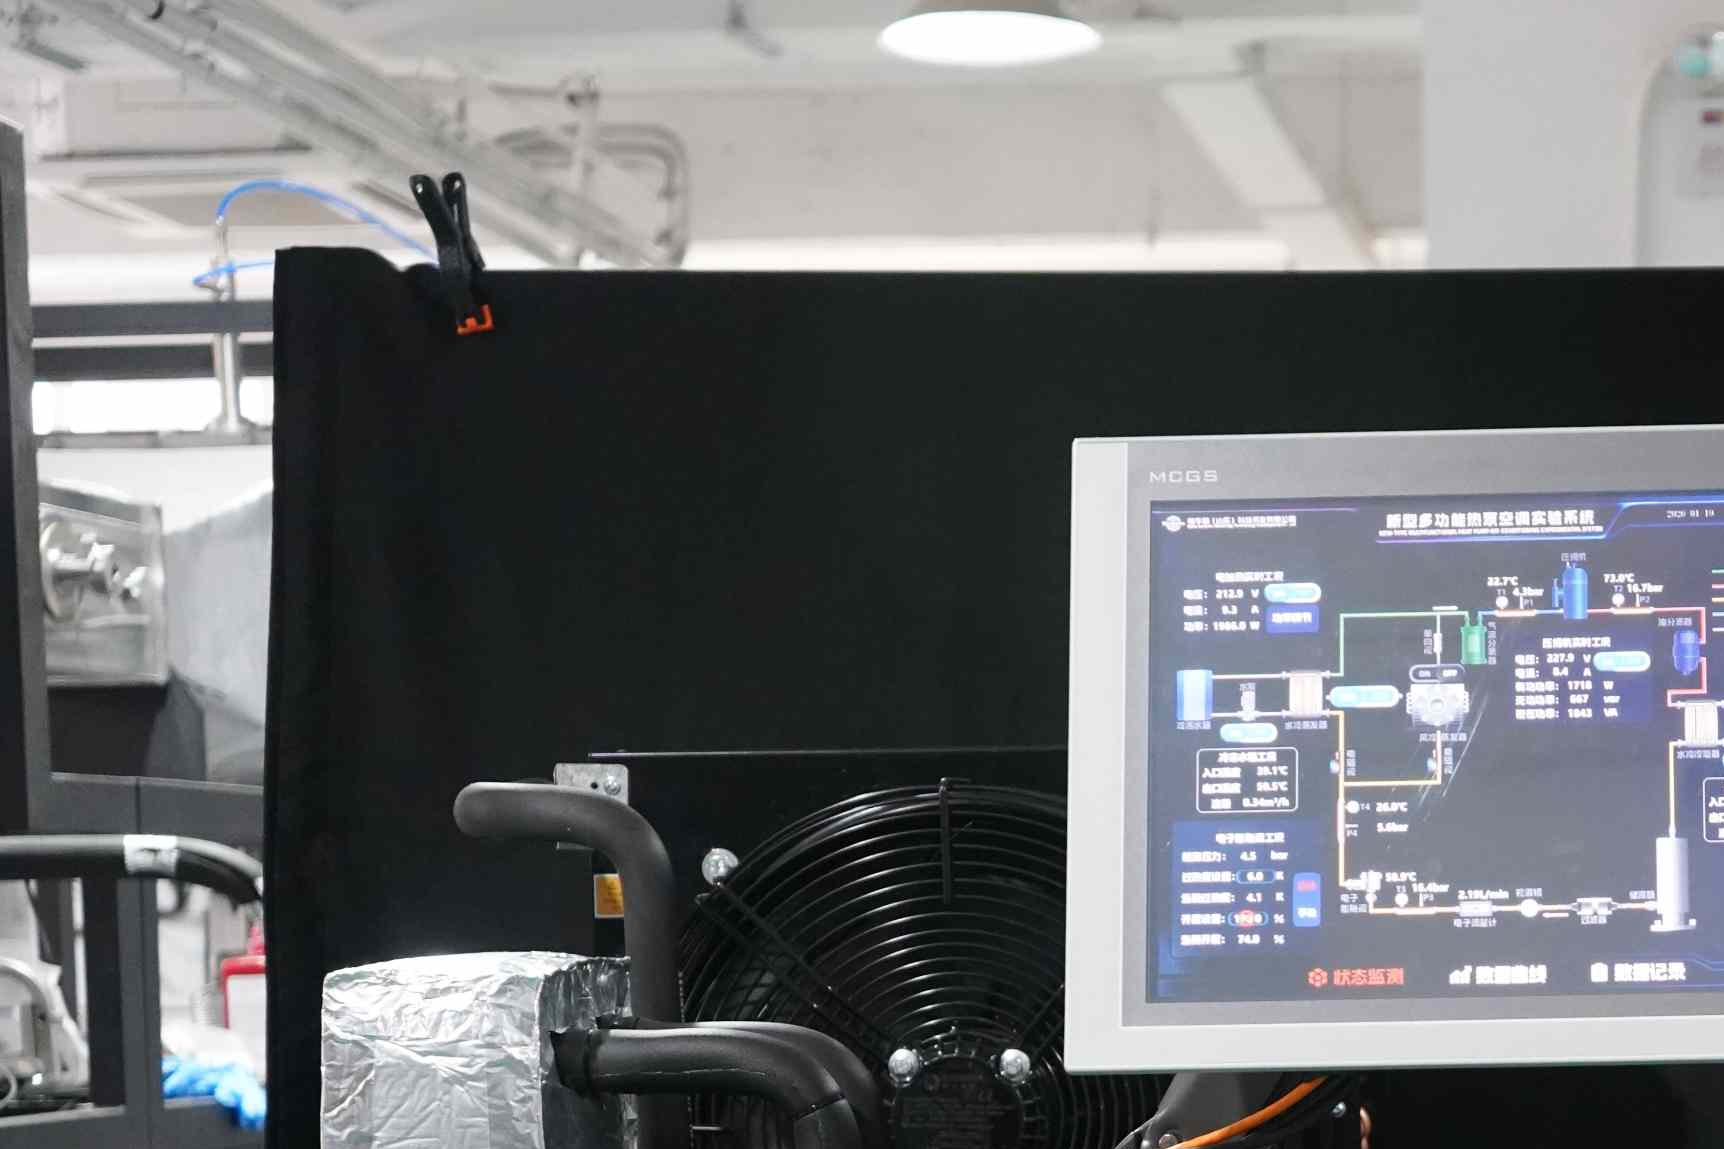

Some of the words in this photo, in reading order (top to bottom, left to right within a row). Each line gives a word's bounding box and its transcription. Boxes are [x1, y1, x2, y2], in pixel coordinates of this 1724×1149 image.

[1149, 470, 1218, 482] MCGS
[1386, 510, 1594, 529] 新型多功能热泵空调实验系统
[1333, 968, 1405, 986] 状态监测
